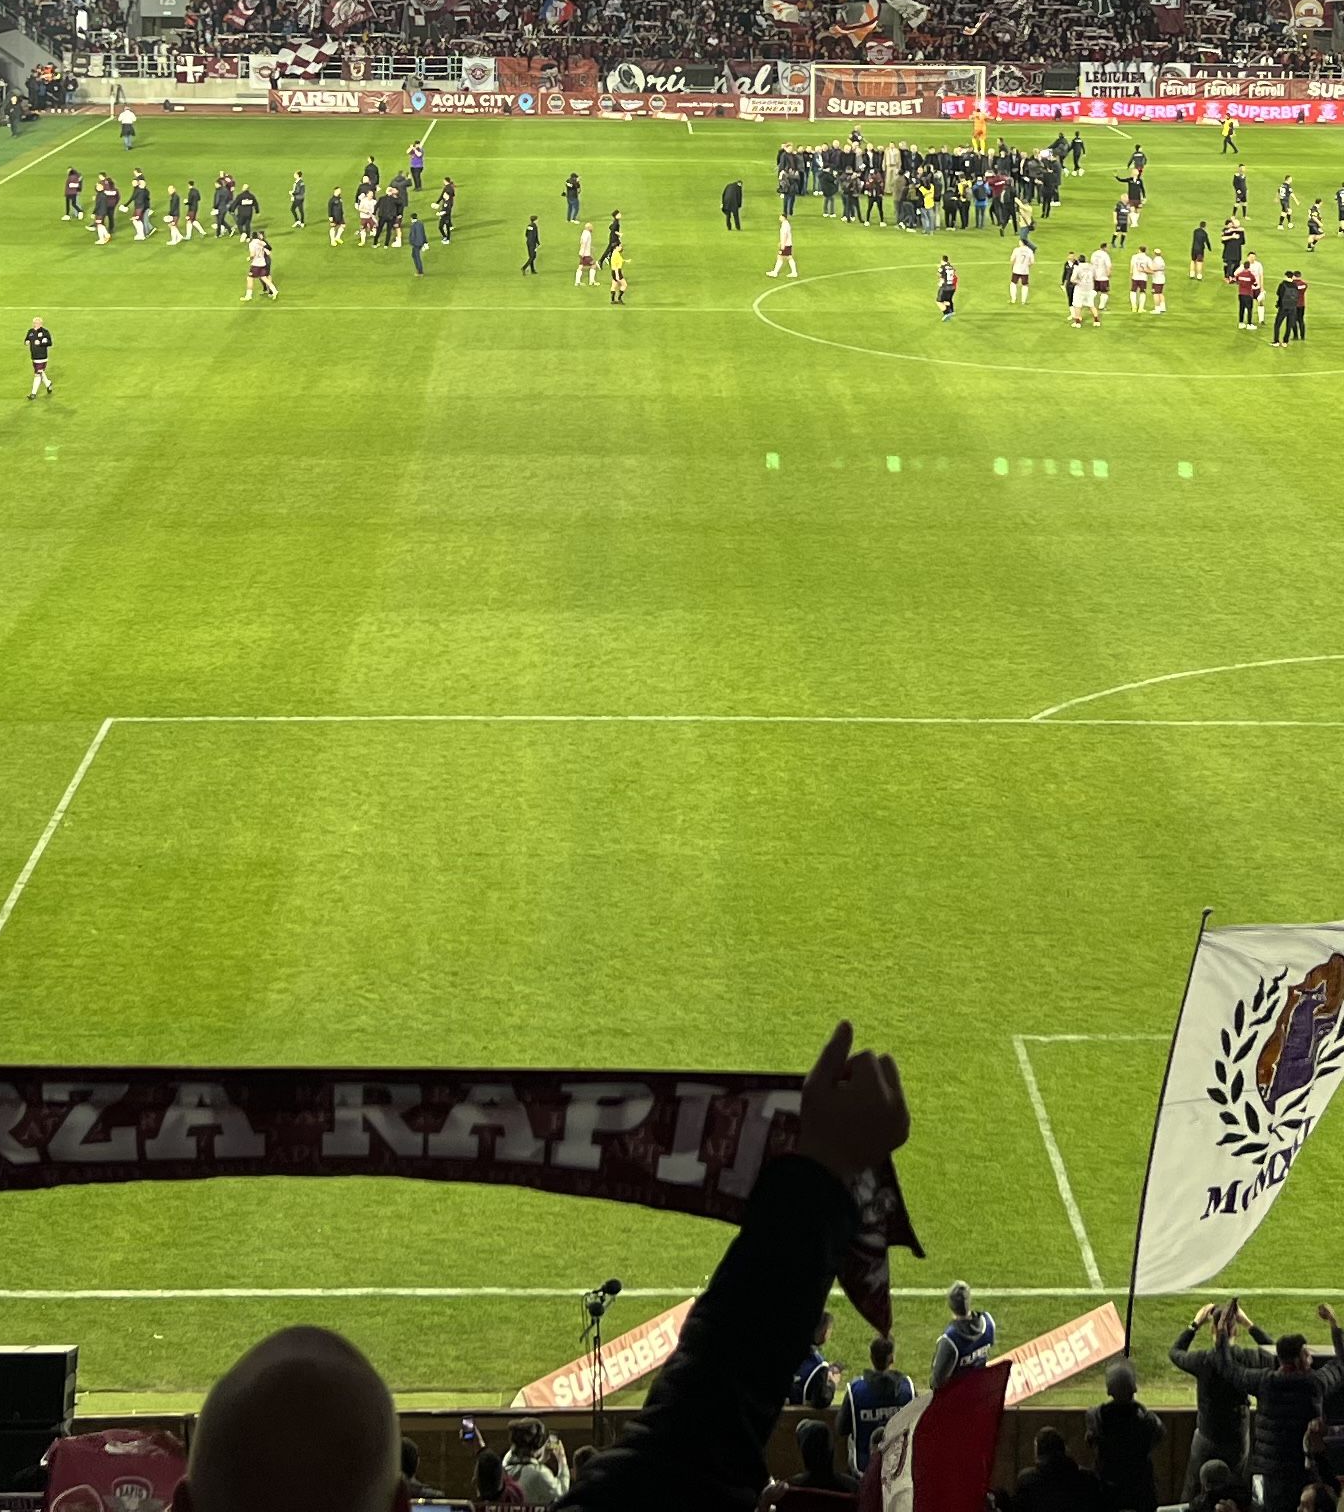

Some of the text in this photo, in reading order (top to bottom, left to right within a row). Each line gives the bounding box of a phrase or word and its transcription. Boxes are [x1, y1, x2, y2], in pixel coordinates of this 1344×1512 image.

[1159, 79, 1196, 97] Ferroli
[1204, 79, 1240, 97] Ferroli
[1249, 80, 1285, 97] Ferroli
[279, 91, 359, 107] TARSIN
[431, 94, 515, 107] AQUA CITY
[827, 98, 924, 116] SUPERBET
[552, 1316, 679, 1407] SUPERBET
[1007, 1320, 1101, 1396] PERBET
